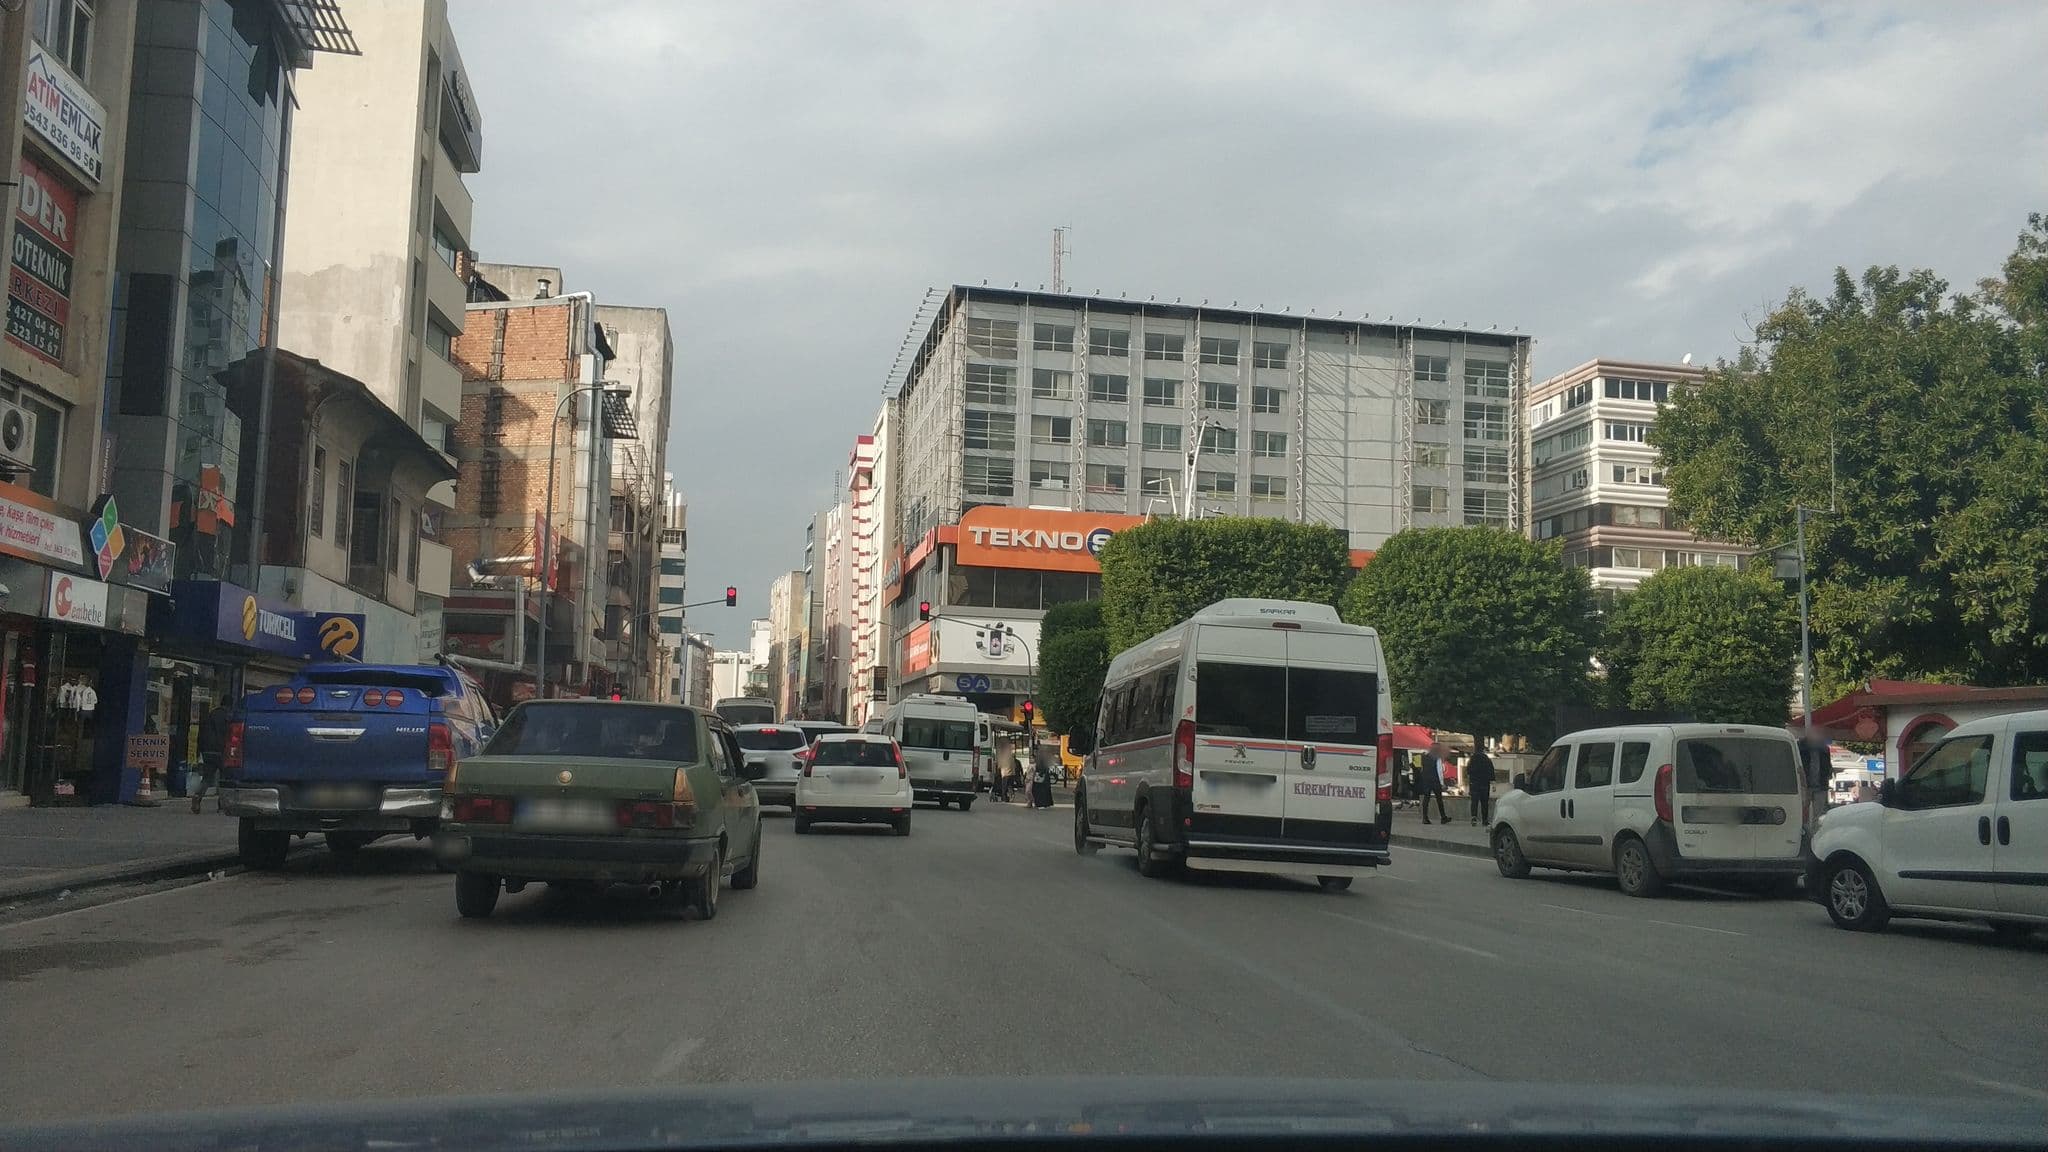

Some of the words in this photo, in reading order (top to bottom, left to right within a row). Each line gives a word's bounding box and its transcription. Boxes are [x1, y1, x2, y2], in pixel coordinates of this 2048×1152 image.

[50, 123, 68, 149] 836
[70, 141, 82, 161] 98
[83, 154, 94, 172] 56
[12, 322, 31, 340] 323
[34, 334, 45, 349] 15
[47, 341, 59, 356] 67
[14, 305, 33, 323] 427
[35, 317, 46, 333] 04
[48, 325, 60, 339] 56
[259, 609, 297, 641] TURKCELL
[1294, 781, 1366, 799] KİREMİTHANE
